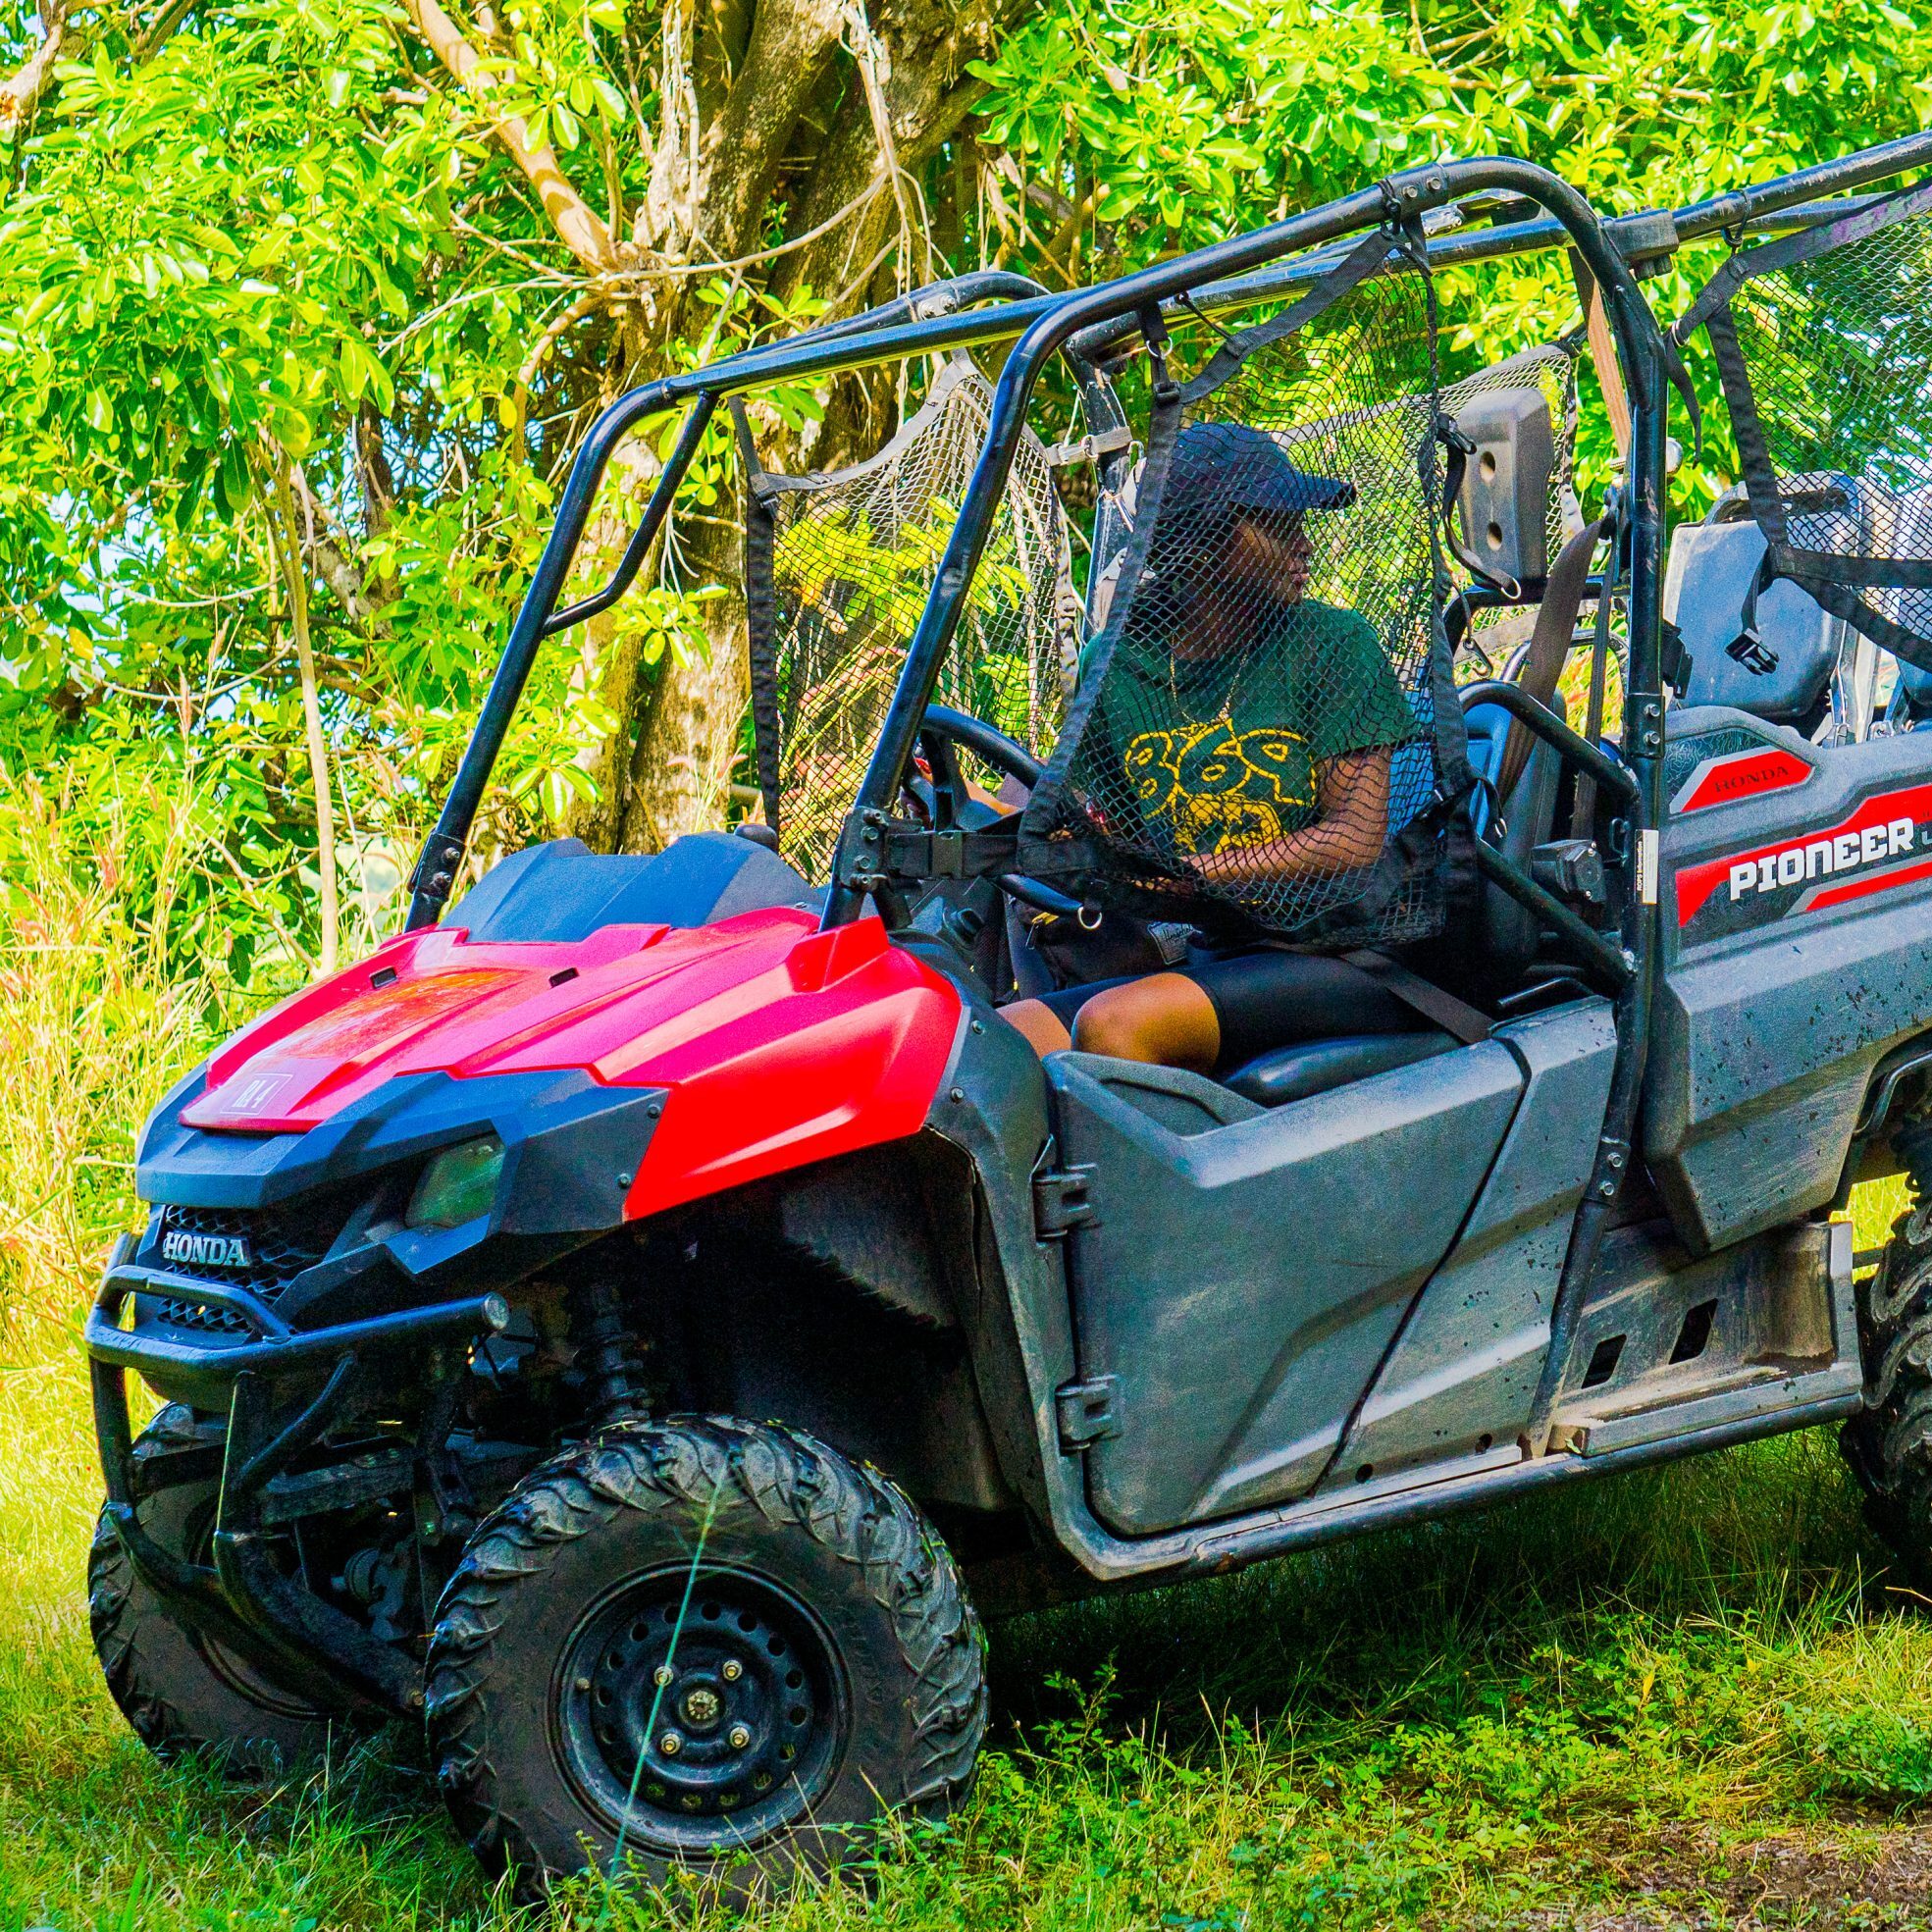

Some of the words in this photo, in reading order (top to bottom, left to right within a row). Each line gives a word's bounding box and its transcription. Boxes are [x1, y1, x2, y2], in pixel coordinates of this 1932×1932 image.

[1714, 765, 1790, 793] HONDA
[1729, 816, 1914, 902] PIONEER
[163, 1231, 250, 1267] HONDA
